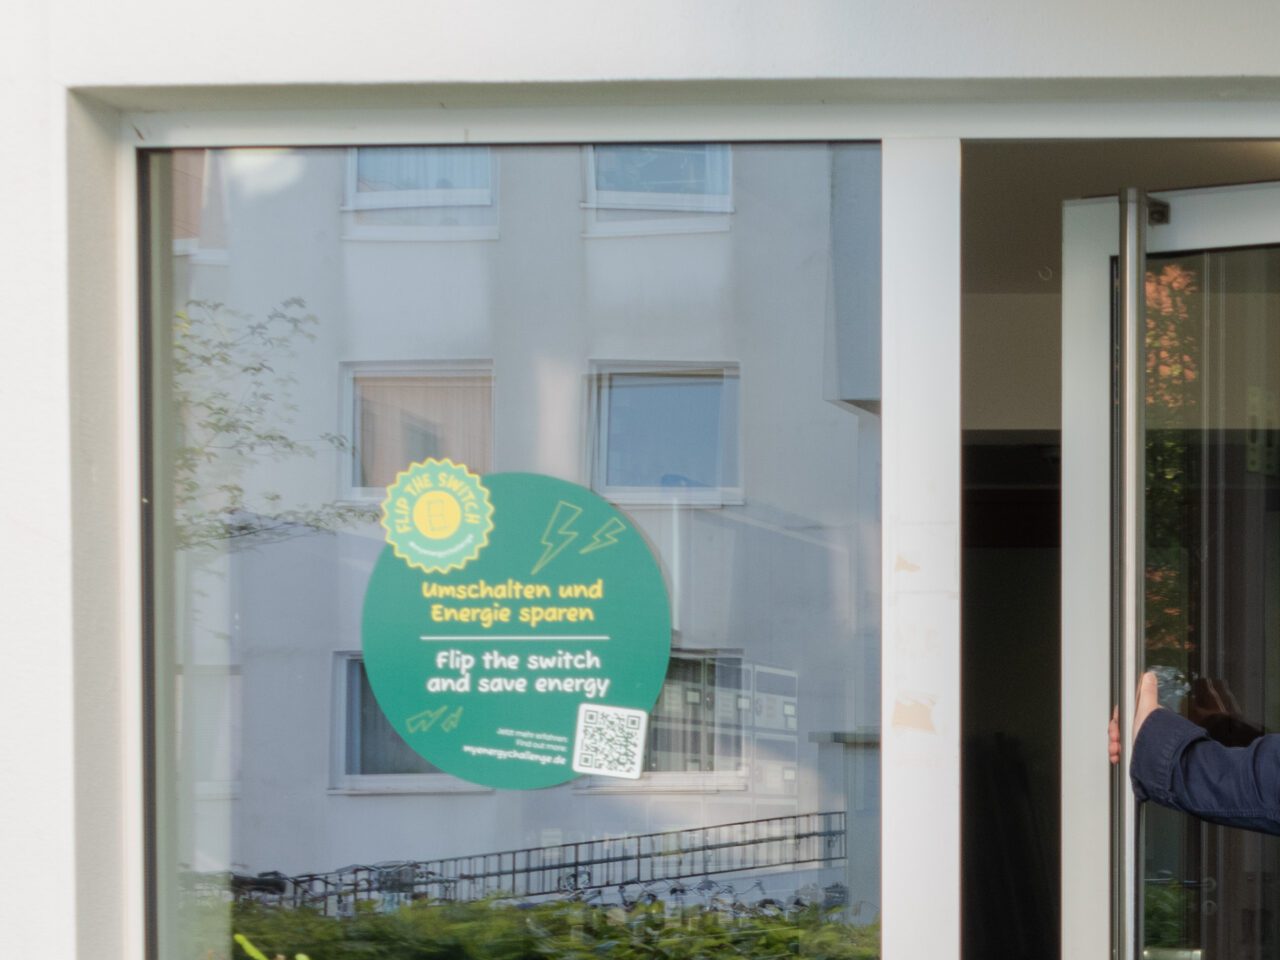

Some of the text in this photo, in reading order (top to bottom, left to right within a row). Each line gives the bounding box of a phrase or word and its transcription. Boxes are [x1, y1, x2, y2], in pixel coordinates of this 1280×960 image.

[395, 473, 481, 533] FLIP THE SWITCH
[422, 578, 604, 599] Umschalten und
[431, 602, 594, 628] Energie sparen
[436, 650, 601, 675] Flip the switch
[427, 672, 610, 698] and save energy
